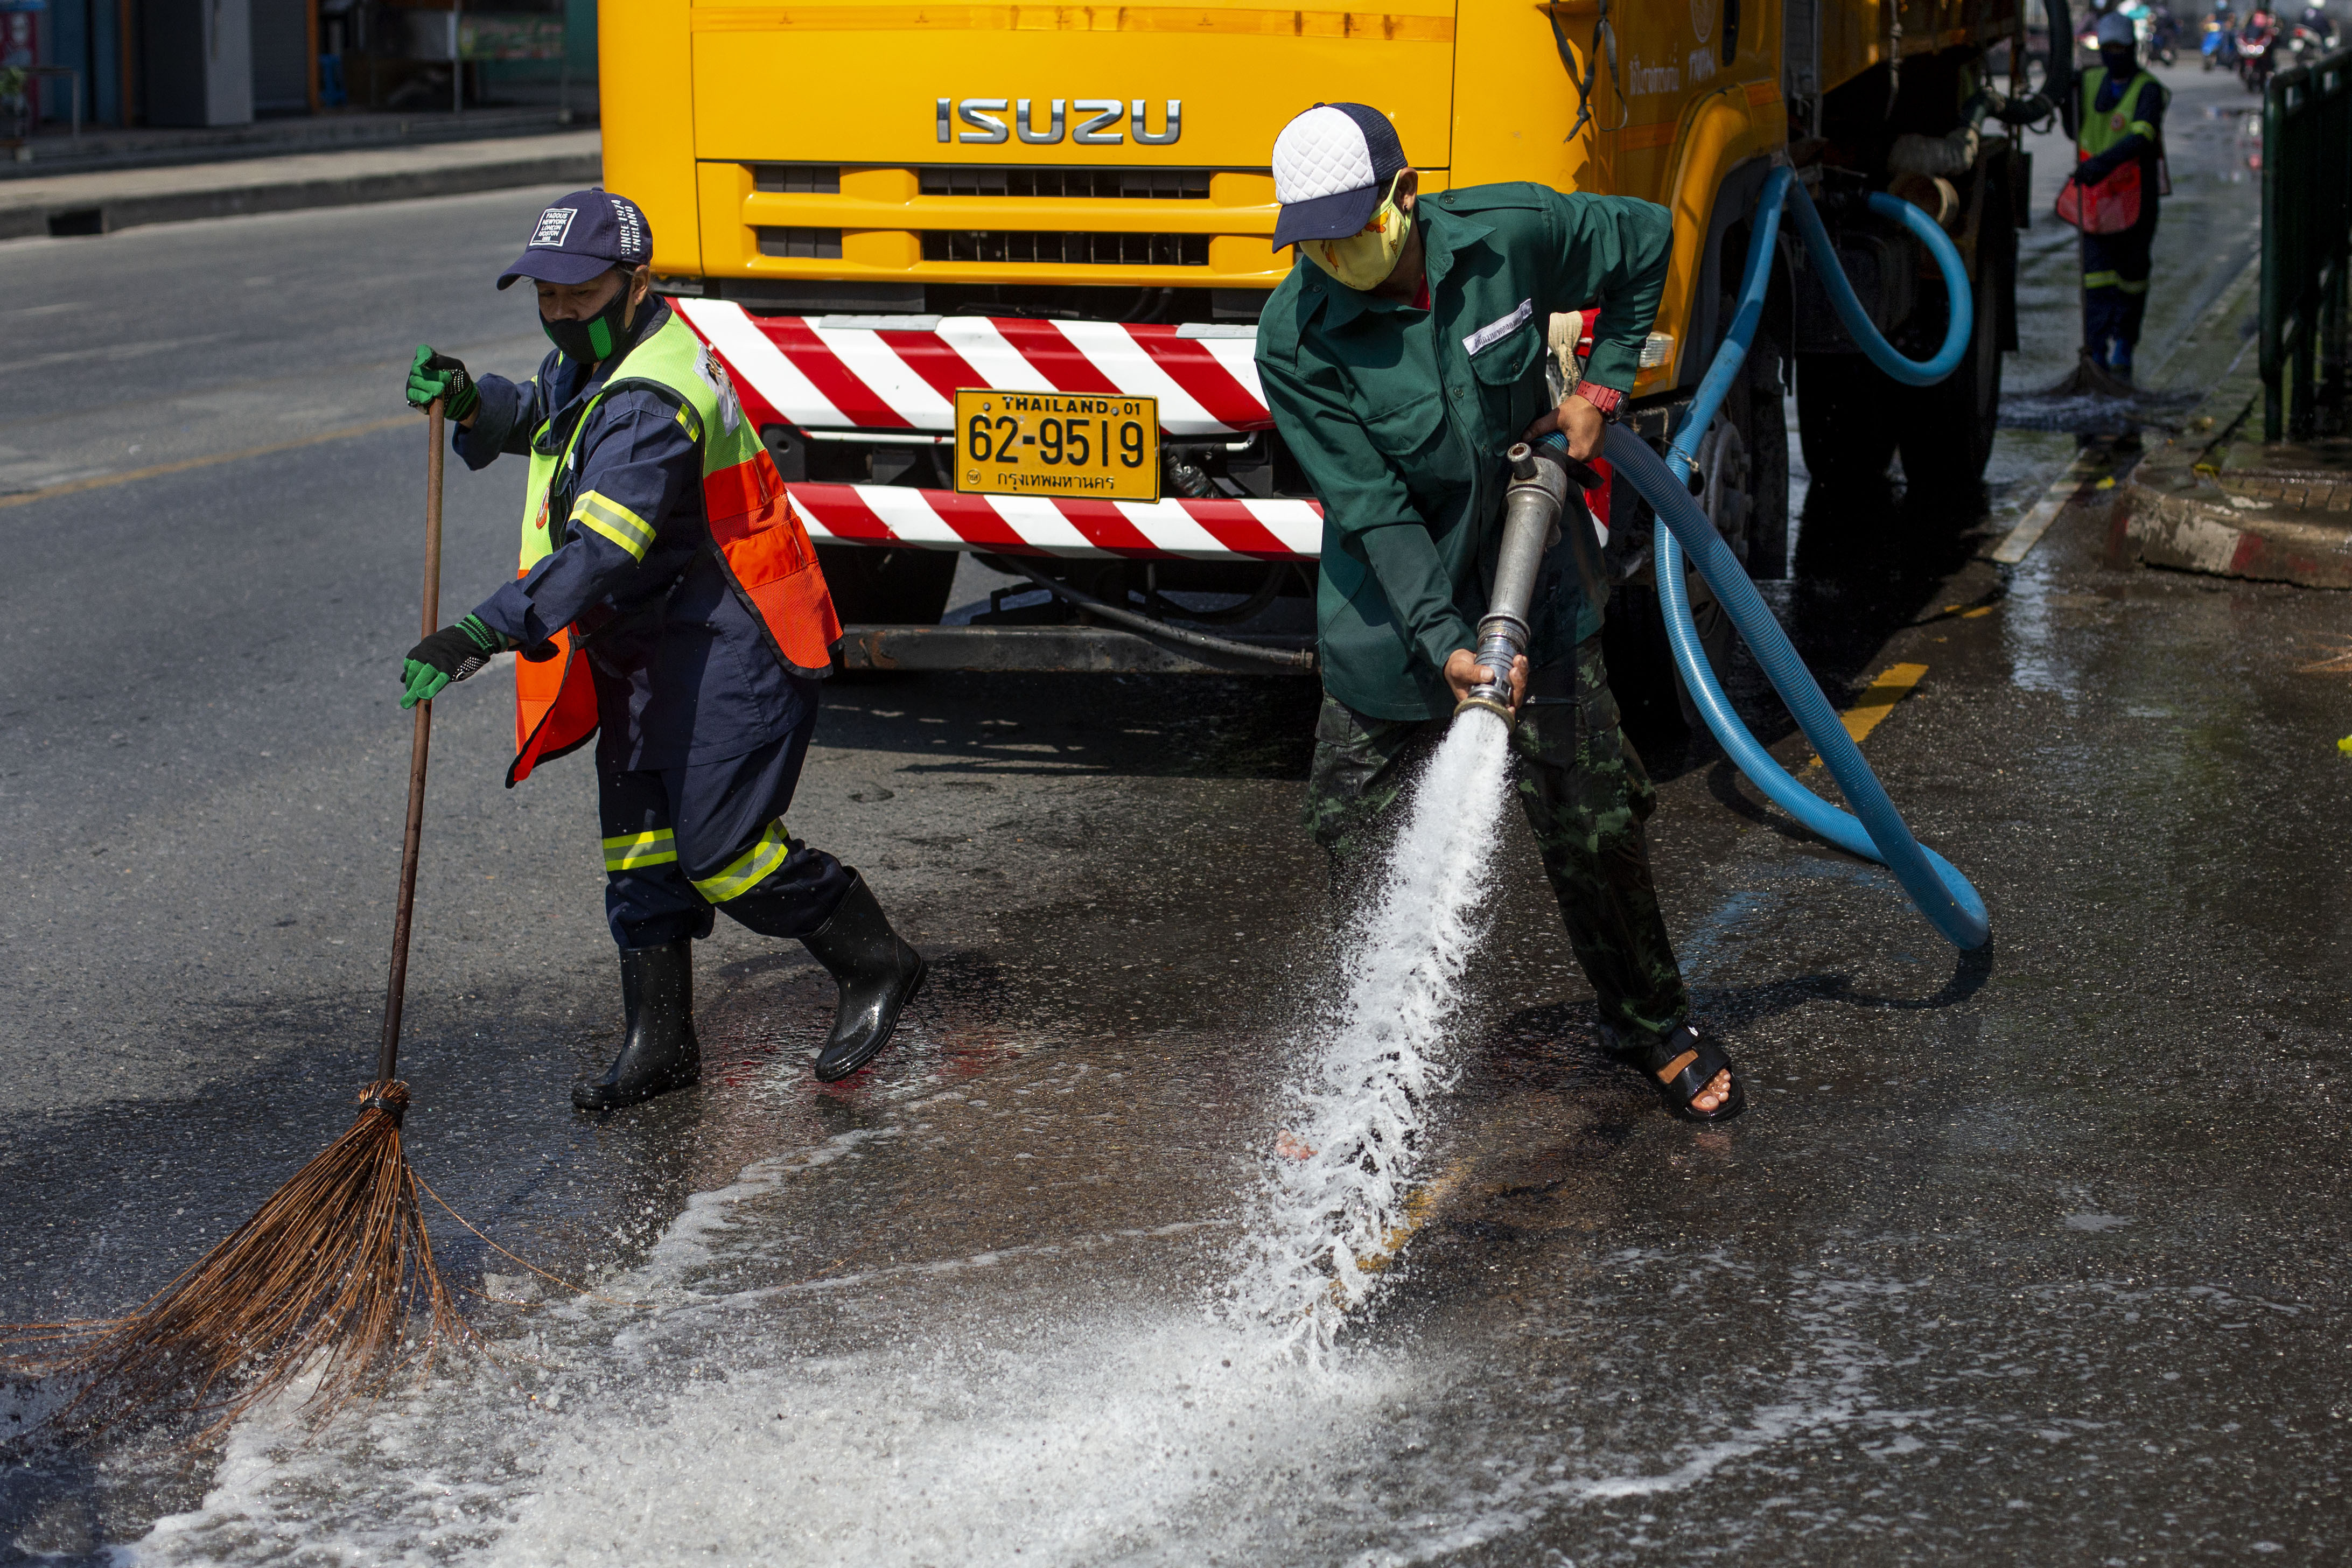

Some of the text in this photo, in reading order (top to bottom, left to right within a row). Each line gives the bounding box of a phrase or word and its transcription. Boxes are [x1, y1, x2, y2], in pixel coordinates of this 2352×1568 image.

[936, 98, 1181, 145] ISUZU
[611, 199, 631, 255] SINCE 1974
[624, 205, 641, 252] ENGLAND
[1002, 396, 1140, 415] THAILAND 01
[969, 414, 1144, 468] 62-9519
[997, 472, 1115, 491] กรุงเทพมหานคร
